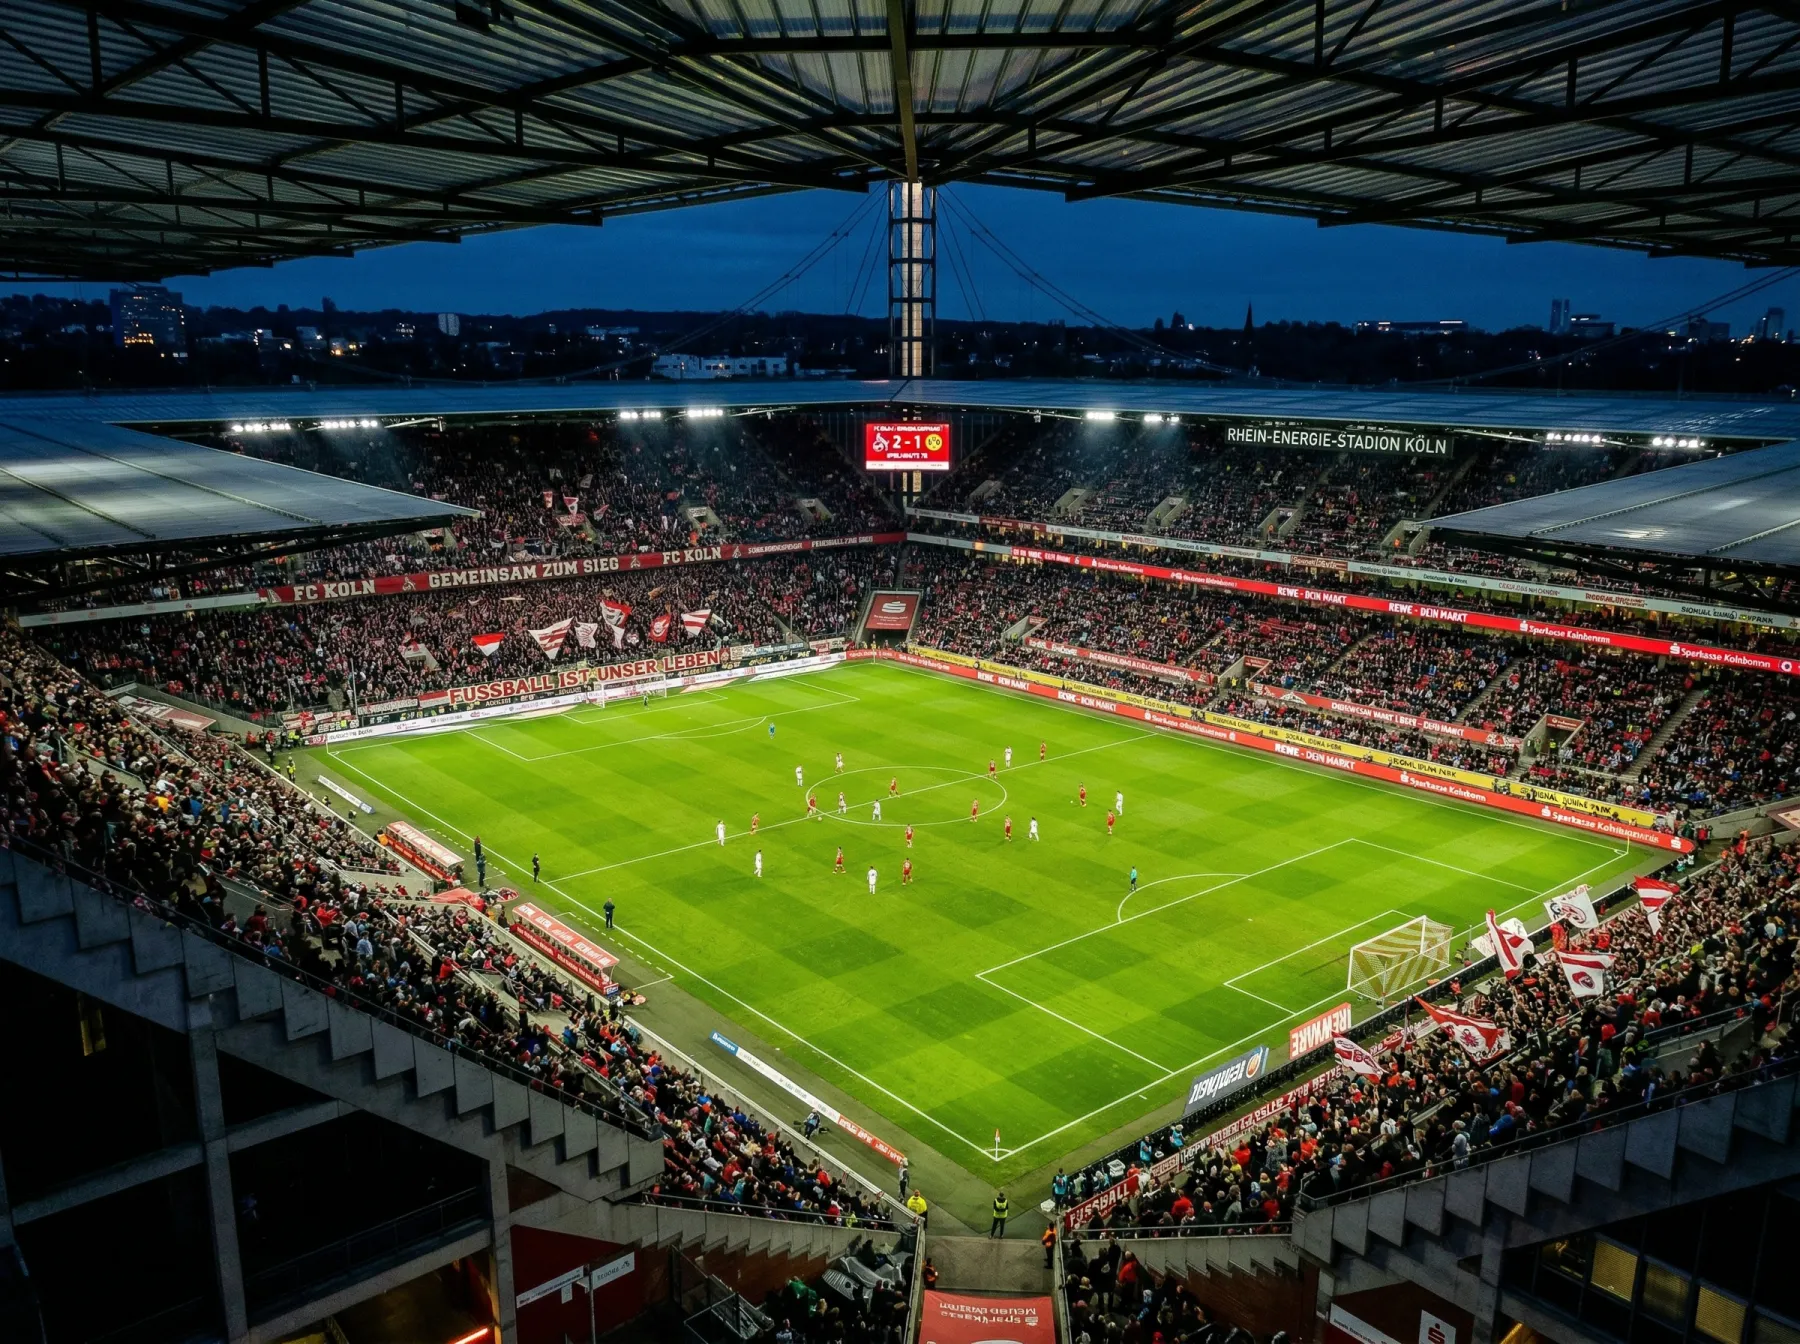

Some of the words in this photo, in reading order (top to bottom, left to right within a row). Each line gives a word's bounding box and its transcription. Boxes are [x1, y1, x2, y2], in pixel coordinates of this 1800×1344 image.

[892, 434, 902, 449] 2
[914, 434, 921, 449] 1
[1227, 427, 1401, 452] RHEIN-ENERGIE-STADION
[1404, 434, 1447, 455] KÖLN
[662, 550, 681, 565] FC
[428, 564, 538, 589] GEMEINSAM
[542, 560, 578, 579] ZUM
[583, 557, 619, 574] SIEG
[293, 585, 319, 601] FC
[1388, 602, 1413, 615] REWE
[449, 674, 554, 705] FUSSBALL
[559, 668, 590, 688] IST
[597, 660, 657, 681] UNSER
[663, 650, 720, 672] LEBEN
